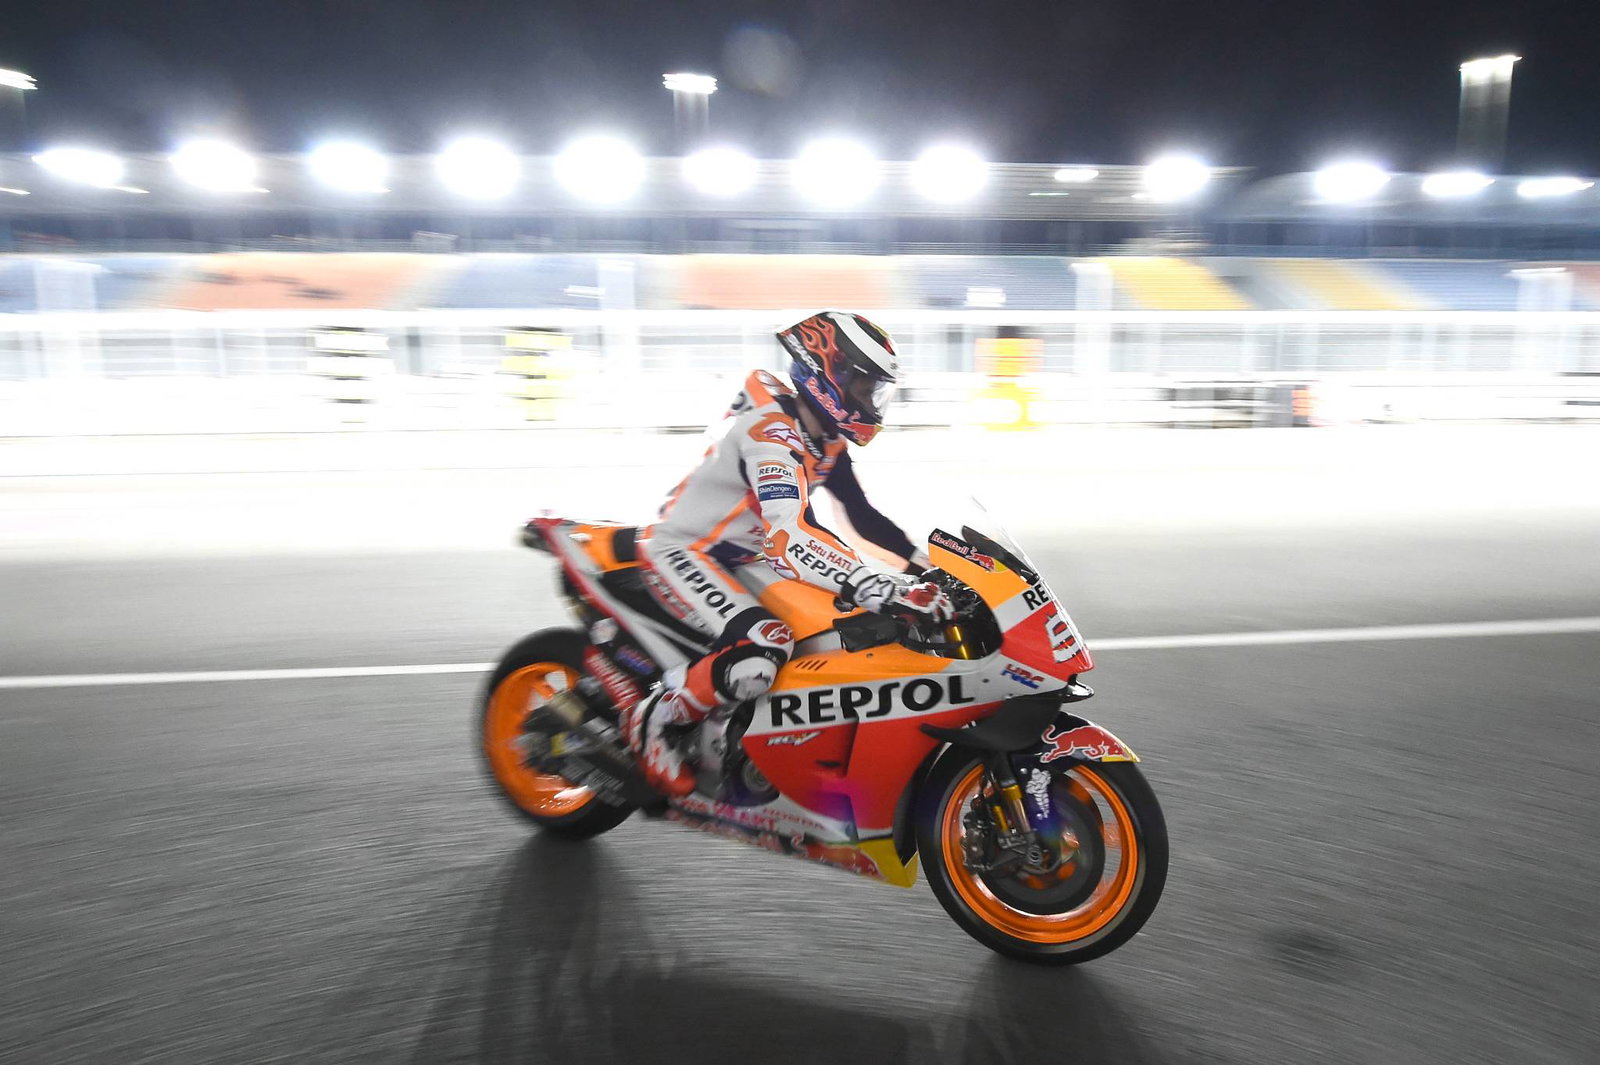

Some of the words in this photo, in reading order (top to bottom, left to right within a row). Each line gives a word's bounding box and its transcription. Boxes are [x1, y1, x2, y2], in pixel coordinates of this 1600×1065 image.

[758, 466, 793, 477] REPSOL
[787, 542, 850, 586] REPSO
[806, 539, 828, 557] Satu
[664, 549, 737, 619] REPSOL
[770, 675, 975, 727] REPSOL
